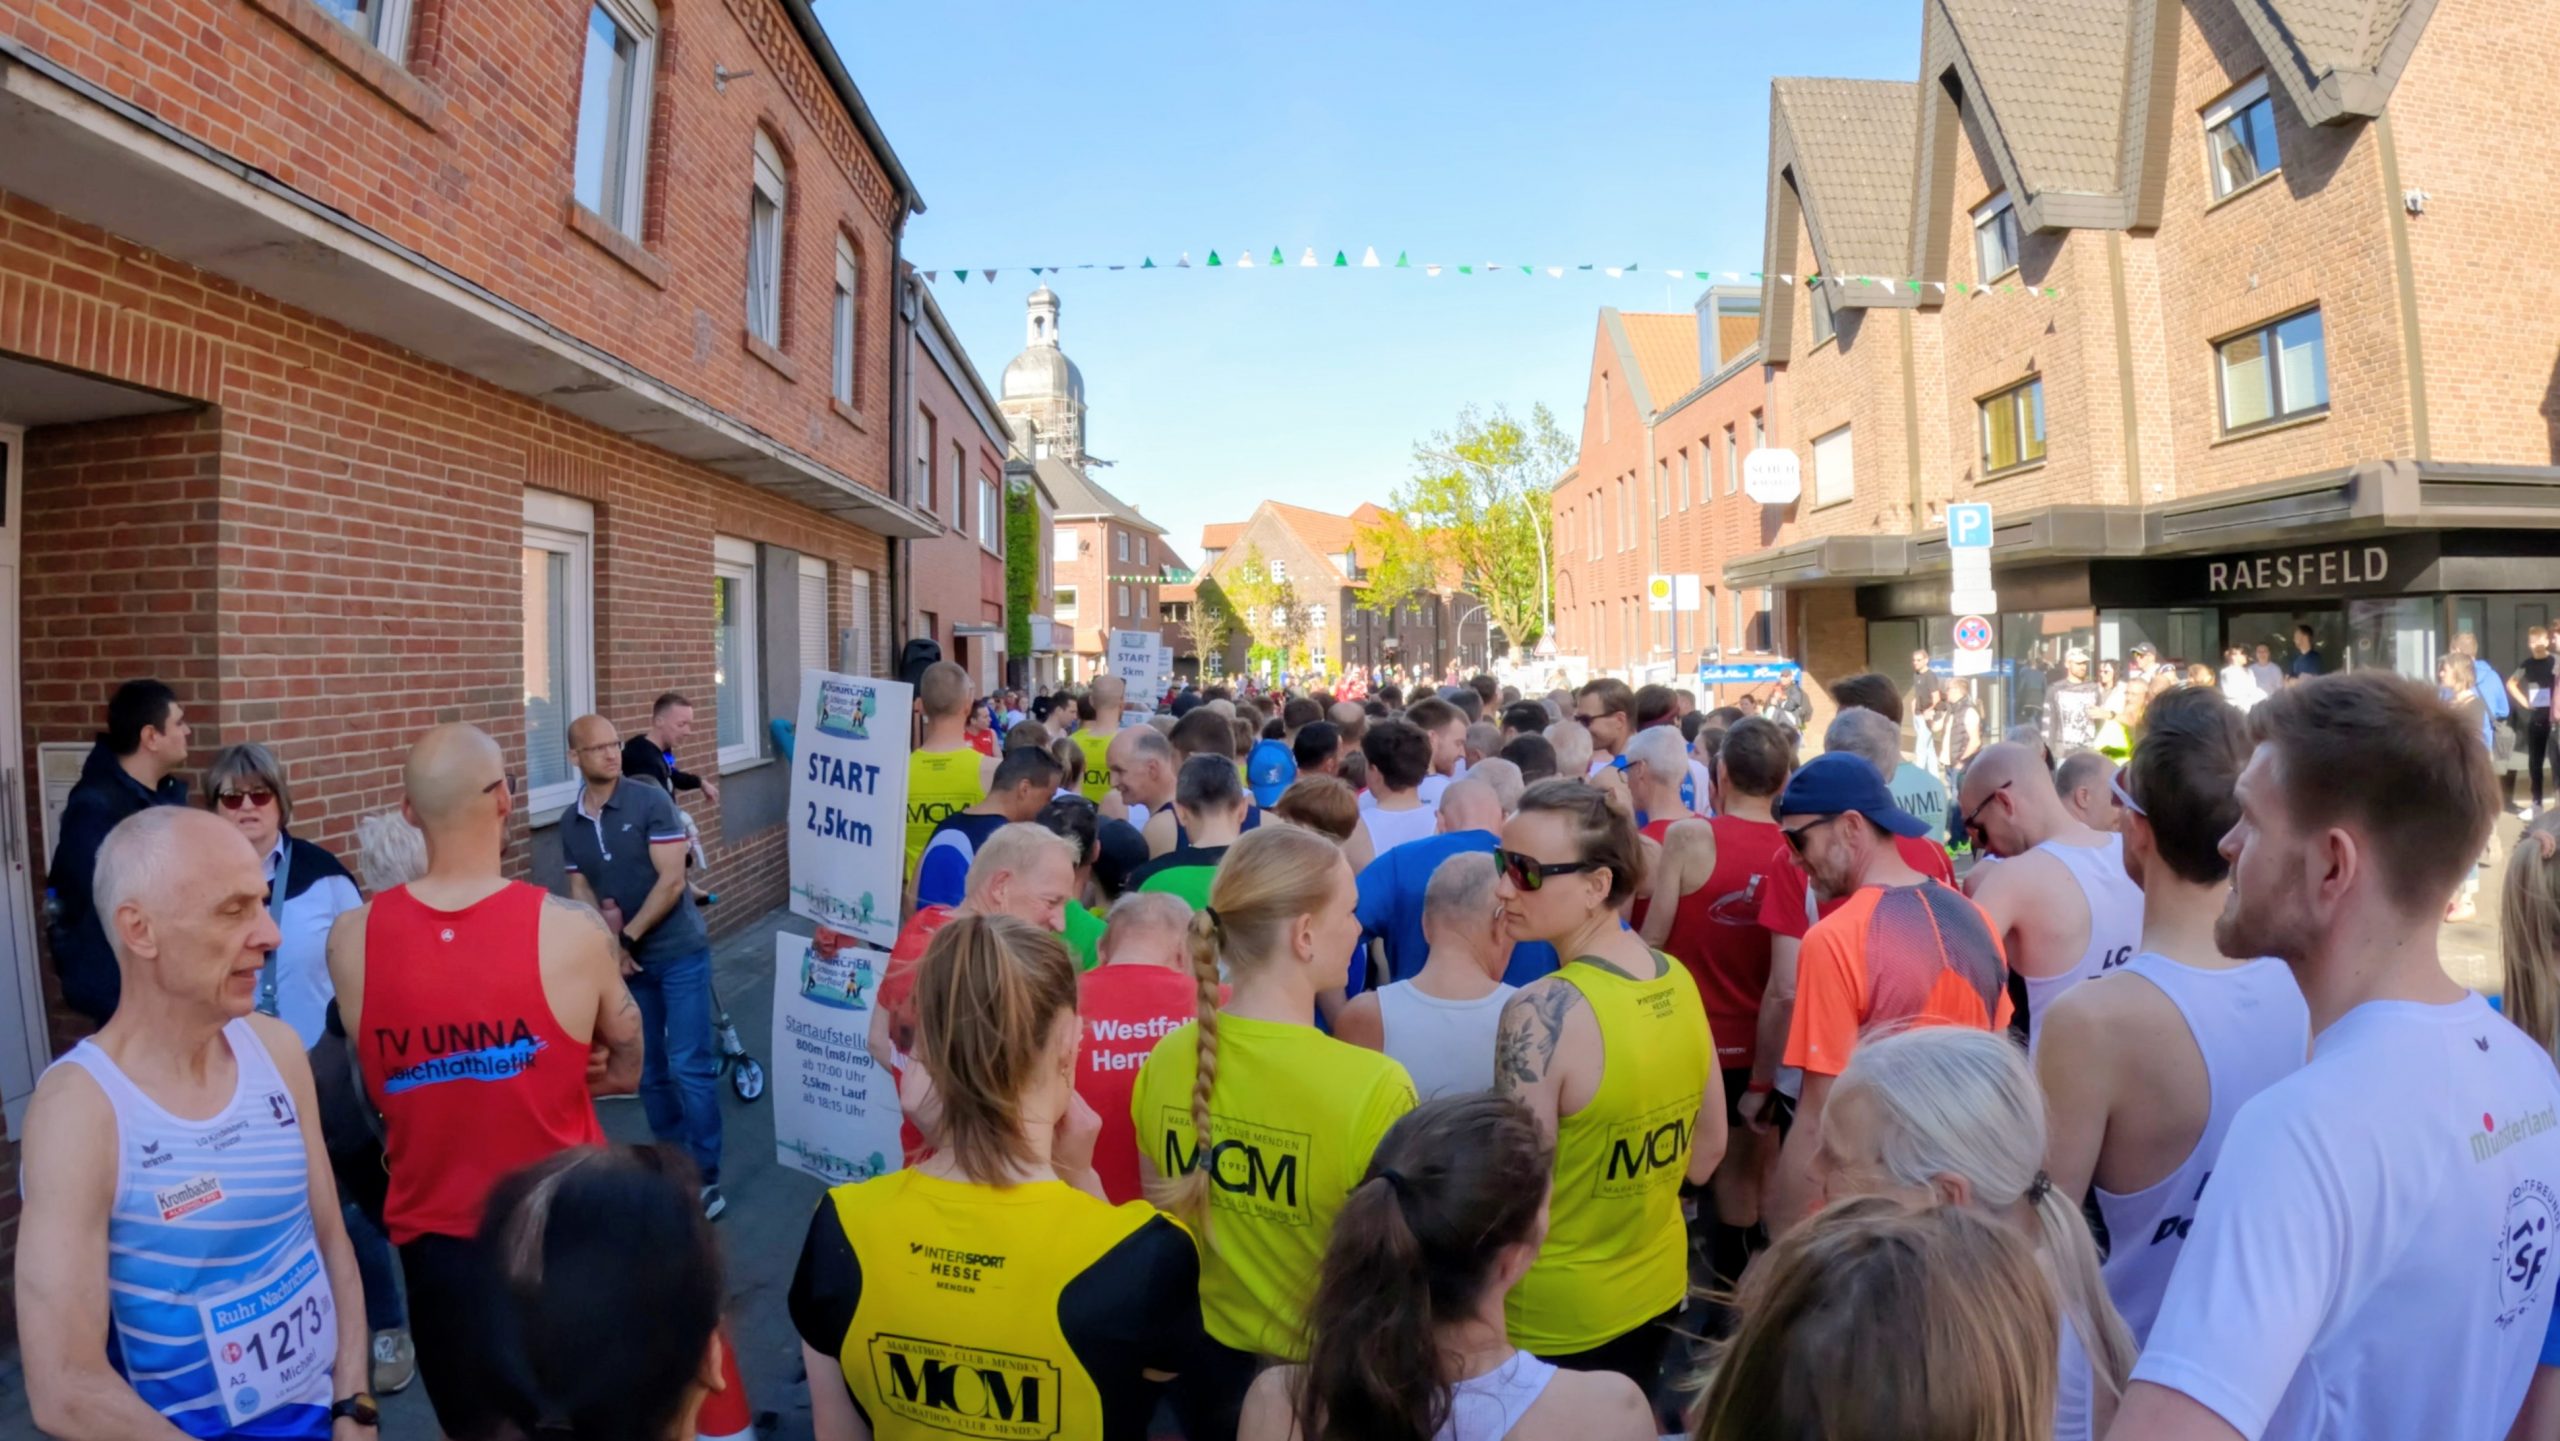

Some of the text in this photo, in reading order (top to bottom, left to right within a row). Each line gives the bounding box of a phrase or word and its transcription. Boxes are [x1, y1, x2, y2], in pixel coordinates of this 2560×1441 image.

[1957, 510, 1982, 543] P
[2209, 547, 2389, 592] RAESFELD
[1118, 652, 1151, 664] START
[1122, 667, 1145, 677] 5km
[808, 751, 880, 796] START
[1084, 769, 1111, 787] CM
[807, 800, 872, 848] 2,5km
[2102, 945, 2132, 970] LC
[375, 1017, 537, 1057] TV UNNA
[796, 1039, 823, 1057] 800m
[802, 1059, 866, 1084] ab 17:00 Uhr
[803, 1092, 815, 1105] ab
[845, 1103, 866, 1118] Uhr
[841, 1085, 867, 1101] Lauf
[157, 1177, 219, 1211] Krombacher
[923, 1246, 1006, 1269] INTERSPORT
[930, 1262, 981, 1282] HESSE
[936, 1281, 976, 1294] MENDEN
[215, 1300, 258, 1329] Ruhr
[246, 1295, 323, 1373] 1273
[886, 1339, 947, 1358] MARATHON
[954, 1351, 984, 1364] CLUB
[991, 1356, 1039, 1373] MENDEN
[229, 1372, 249, 1388] A2
[883, 1351, 1047, 1424] MCM
[957, 1418, 988, 1431] CLUB
[993, 1422, 1042, 1436] MENDEN
